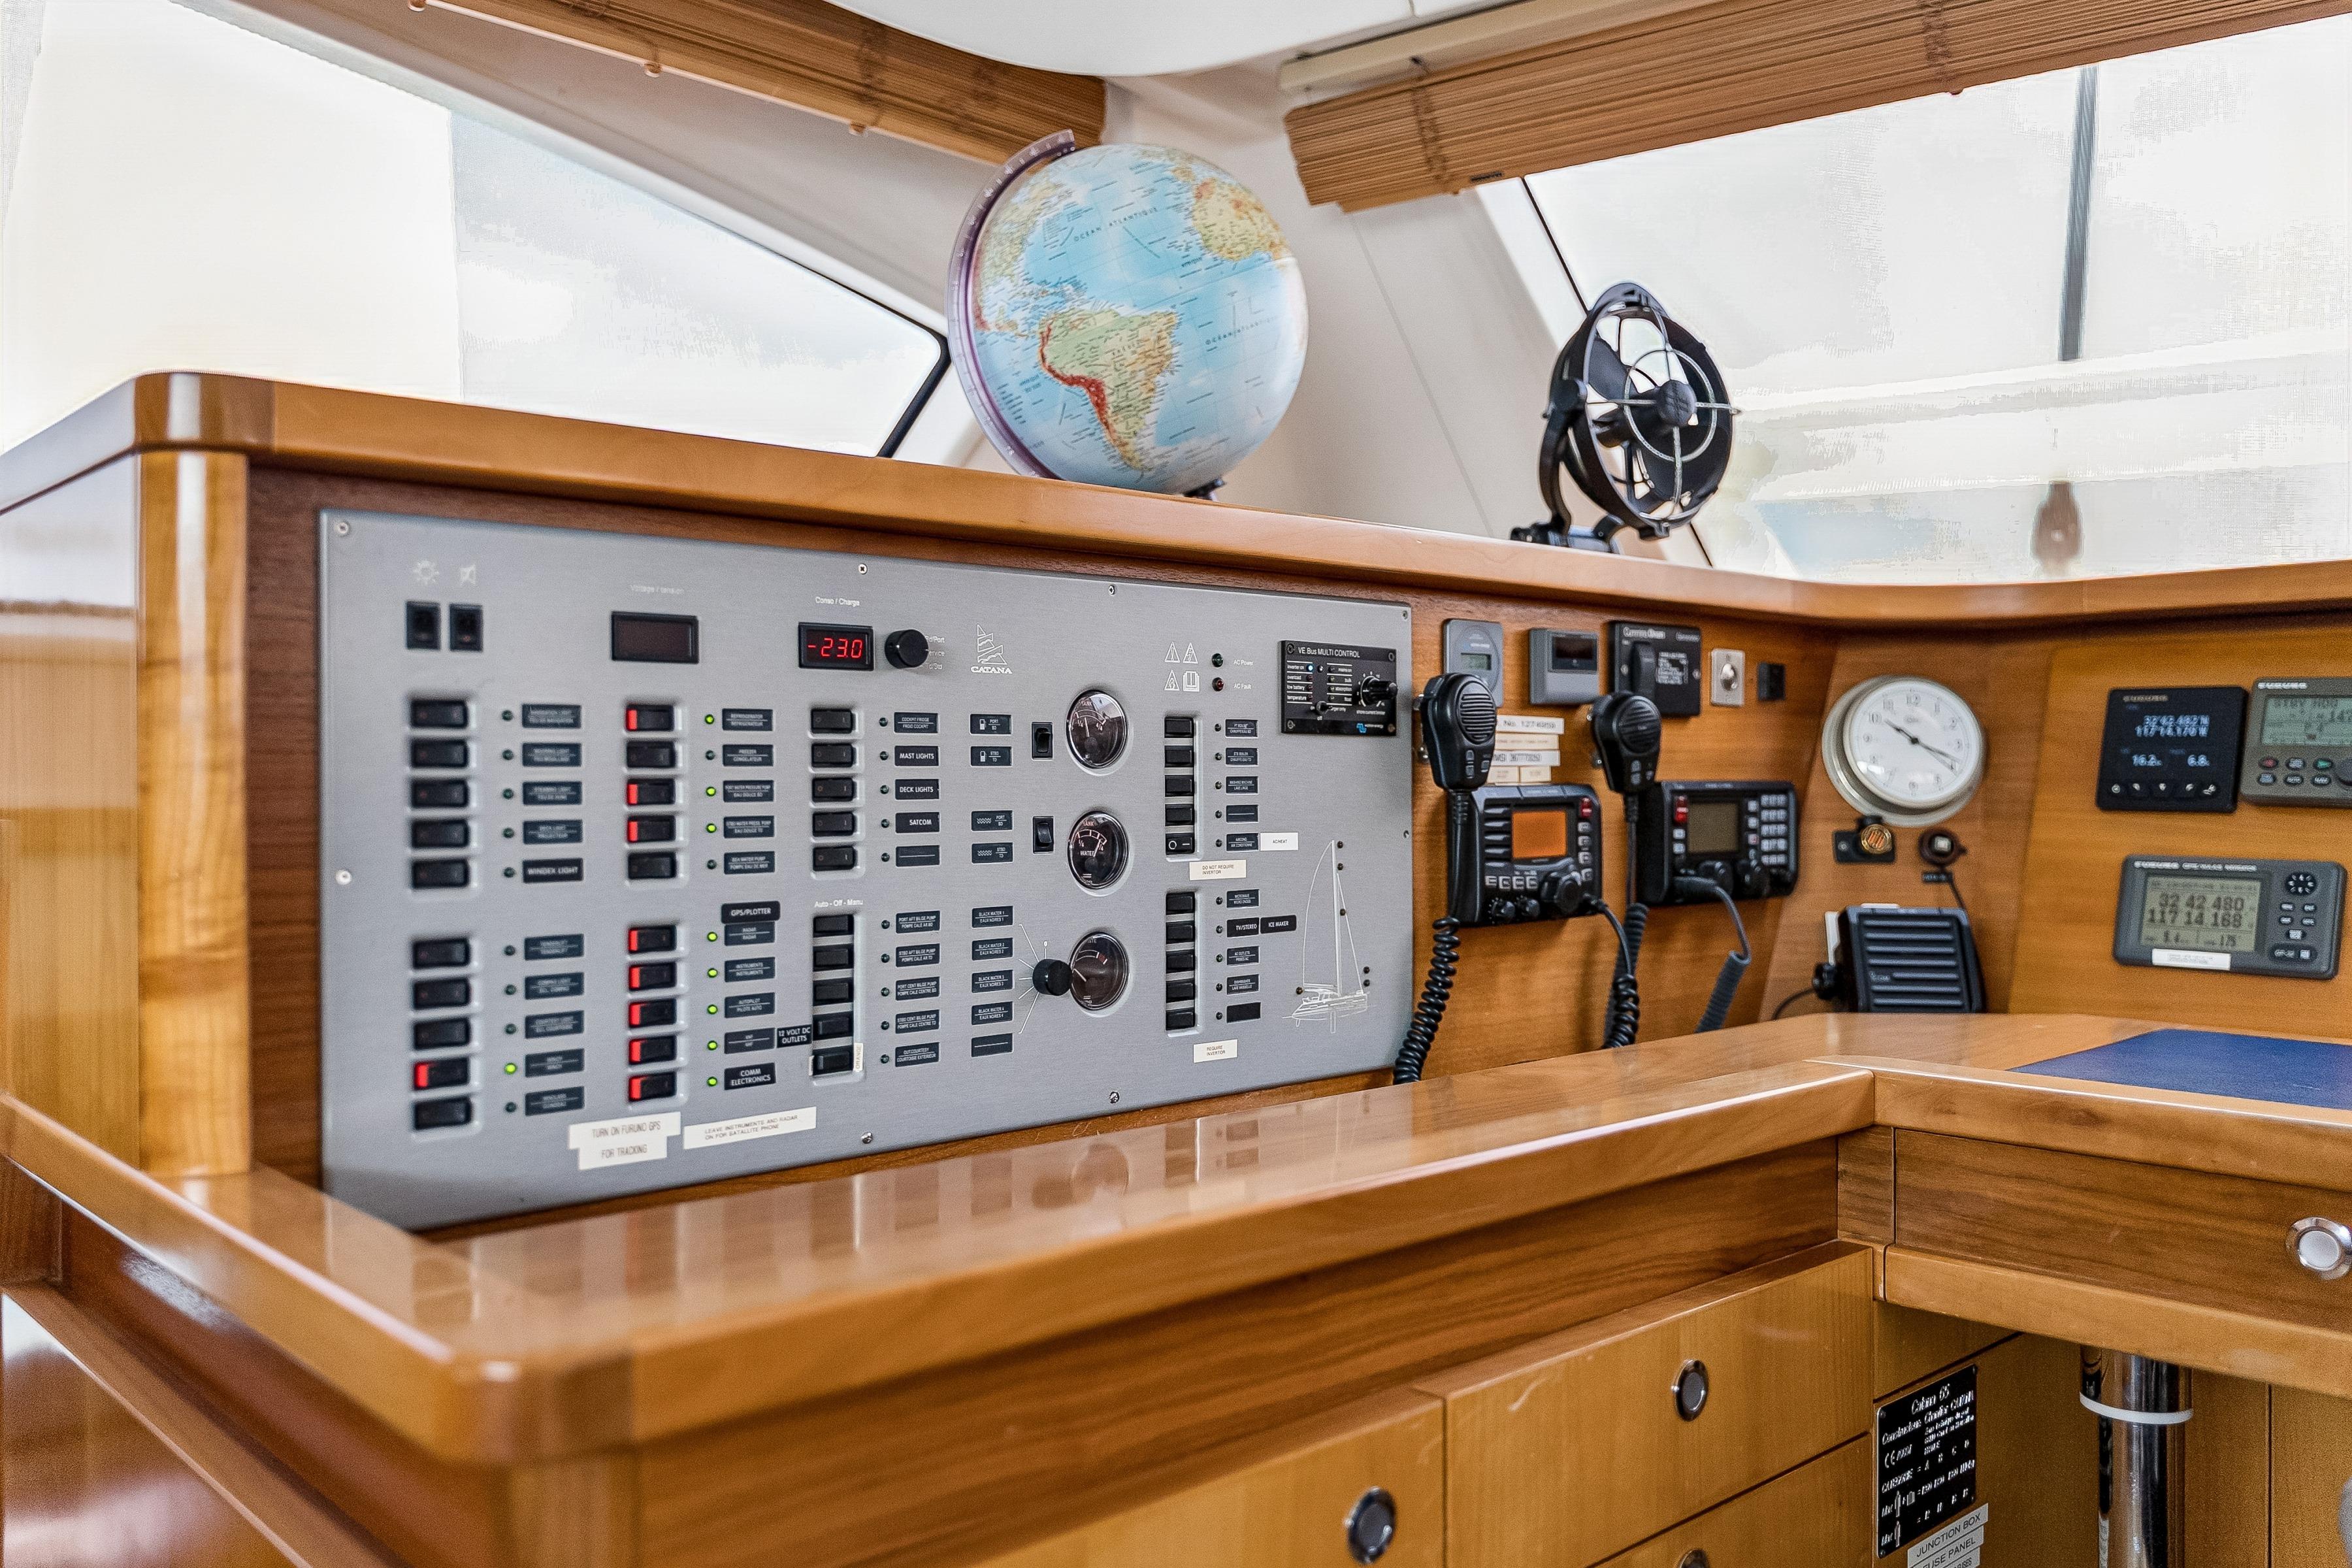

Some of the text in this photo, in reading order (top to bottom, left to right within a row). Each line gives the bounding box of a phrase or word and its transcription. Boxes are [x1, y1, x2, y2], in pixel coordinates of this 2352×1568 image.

[815, 596, 860, 607] Conso Charge
[1906, 694, 1921, 706] 12
[1869, 713, 1882, 724] 10
[528, 867, 555, 875] WINDEX
[730, 907, 772, 917] GPS/PLOTTER
[782, 1035, 808, 1044] OUTLETS
[740, 1068, 761, 1077] COMM
[731, 1075, 772, 1086] ELECTRONICS
[592, 1120, 661, 1138] TURN ON FURUNO GPS
[704, 1126, 723, 1134] LEAVE
[602, 1144, 647, 1160] FOR TRACKING
[1916, 1512, 1981, 1558] JUNCTION BOX
[1948, 1537, 1976, 1558] PANEL
